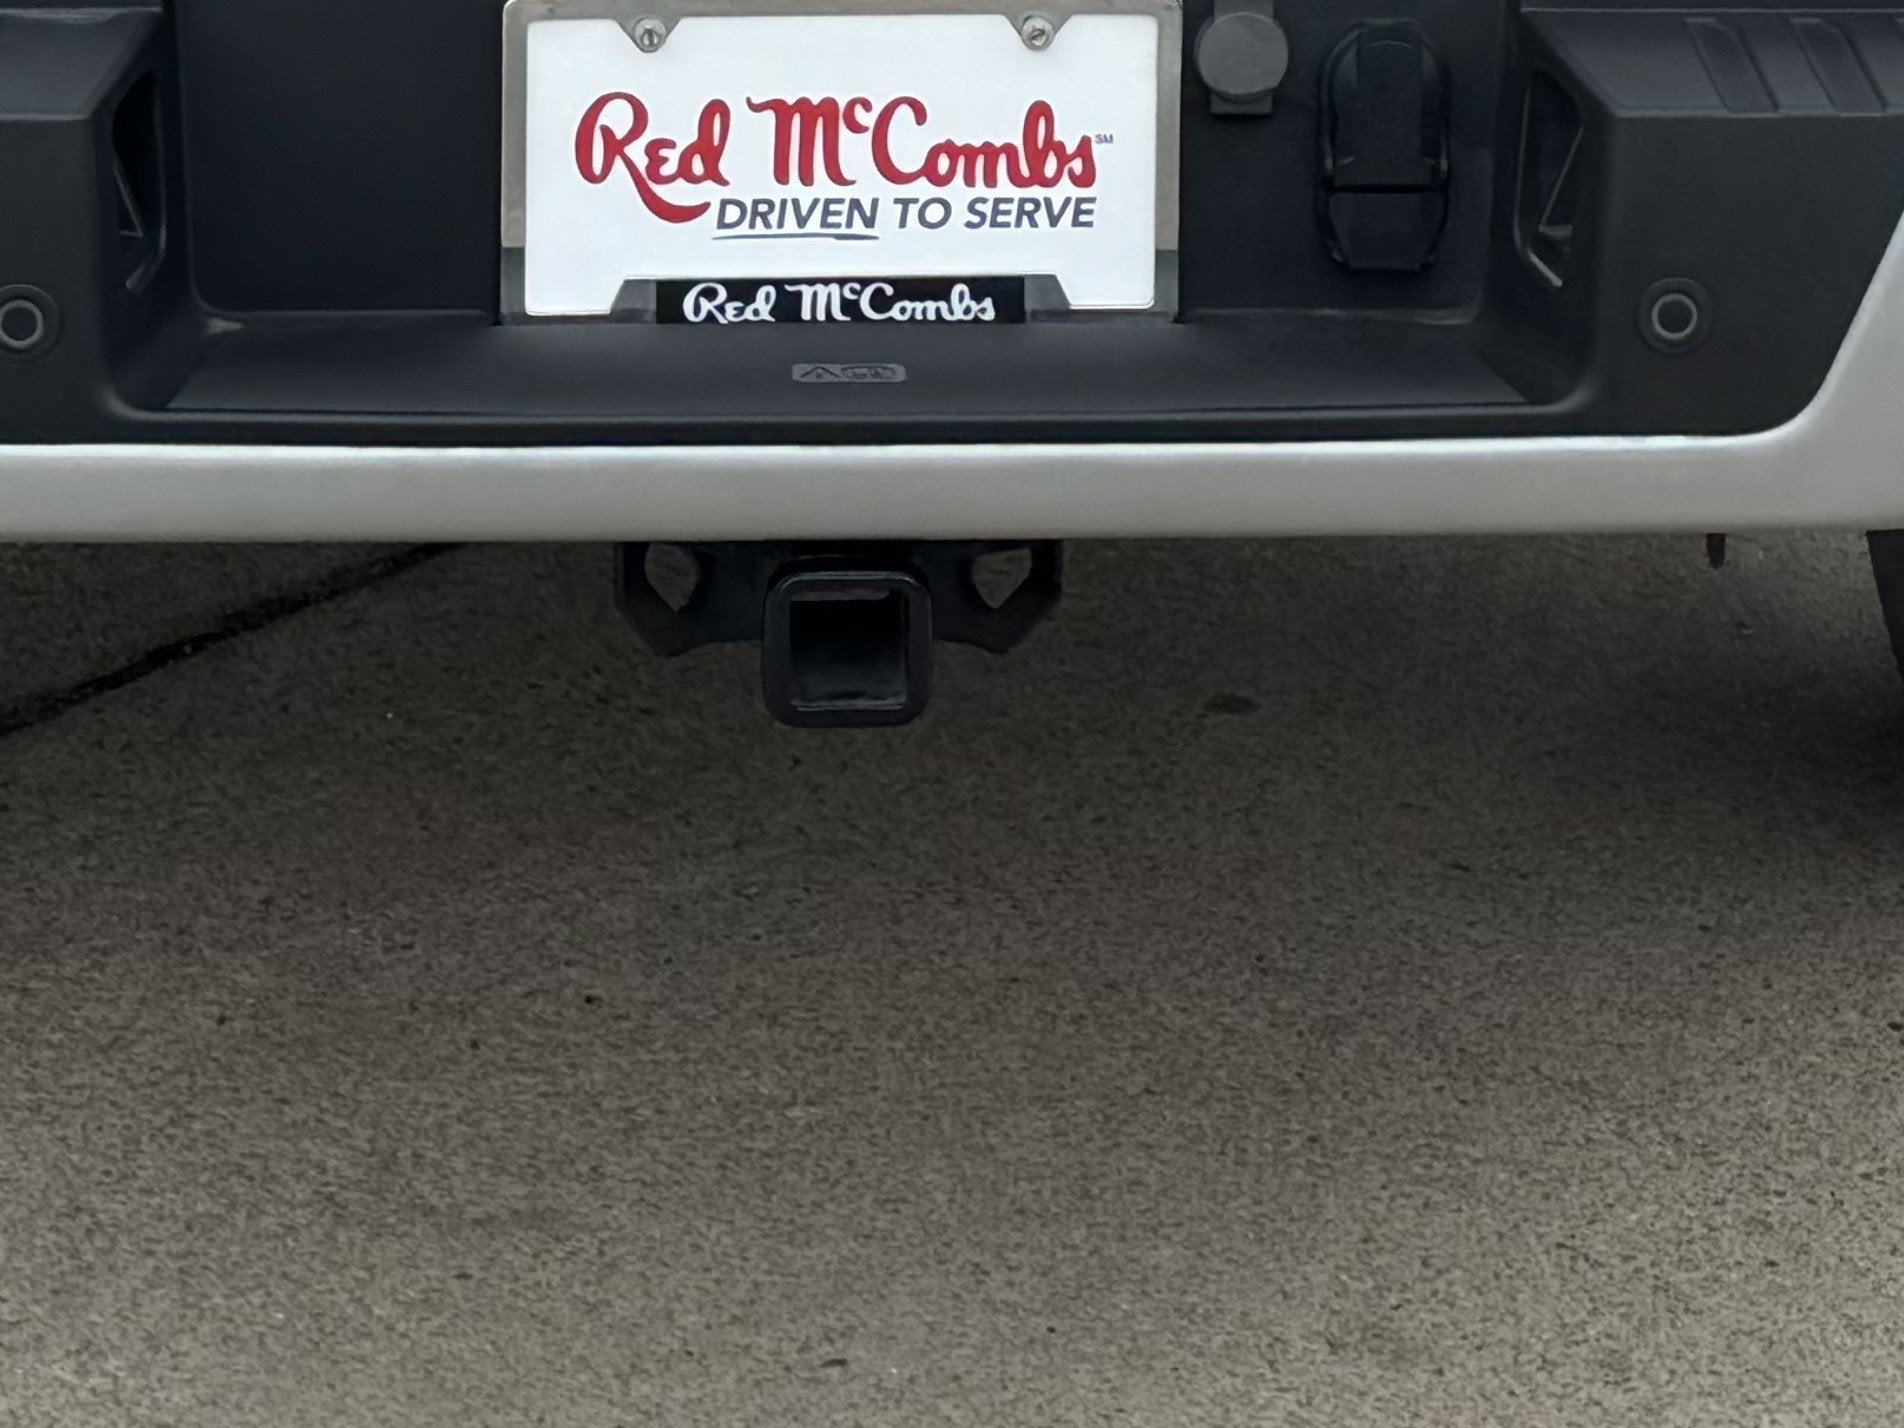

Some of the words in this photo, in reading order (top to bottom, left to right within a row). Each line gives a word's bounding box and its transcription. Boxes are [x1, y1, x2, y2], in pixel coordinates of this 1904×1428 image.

[574, 91, 732, 224] Red
[746, 95, 1098, 189] McCombs
[715, 196, 880, 231] DRIVEN
[892, 196, 953, 231] TO
[964, 196, 1098, 230] SERVE
[682, 282, 777, 325] Red
[784, 282, 997, 323] McCombs
